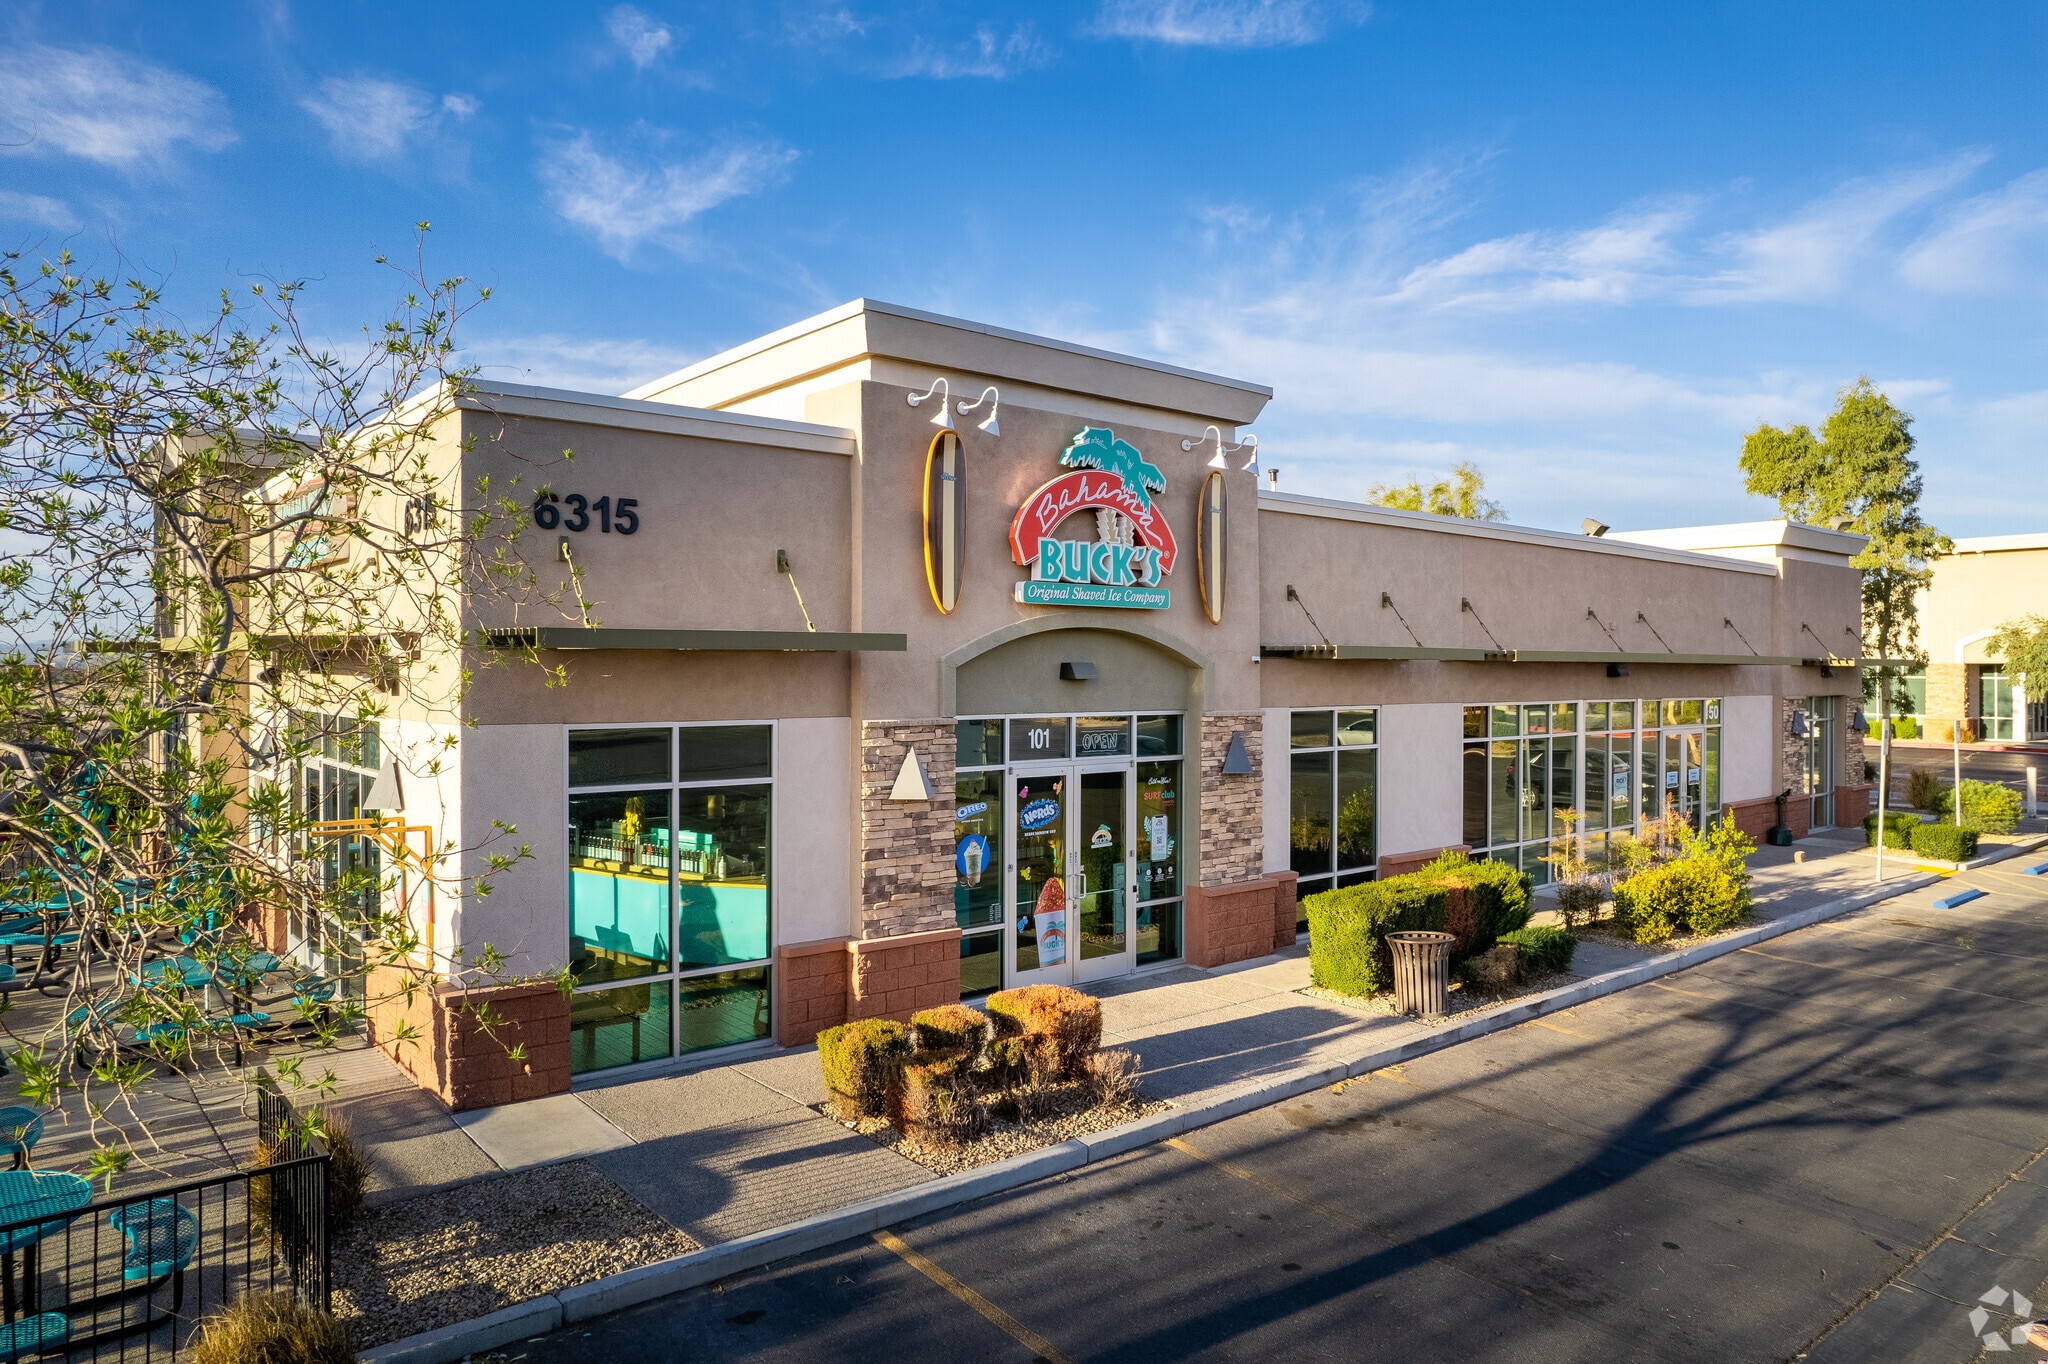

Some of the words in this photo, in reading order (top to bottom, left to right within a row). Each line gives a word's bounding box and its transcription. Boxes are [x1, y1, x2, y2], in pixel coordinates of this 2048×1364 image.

[533, 493, 639, 535] 6315
[1036, 476, 1163, 547] Bahama
[1037, 537, 1164, 588] BUCK'S
[1028, 585, 1070, 601] Original
[1072, 587, 1107, 601] Shaved
[1109, 589, 1122, 602] Ice
[1124, 590, 1166, 606] Company
[1028, 728, 1050, 749] 101
[1082, 733, 1118, 750] OPEN
[957, 802, 987, 819] OREO
